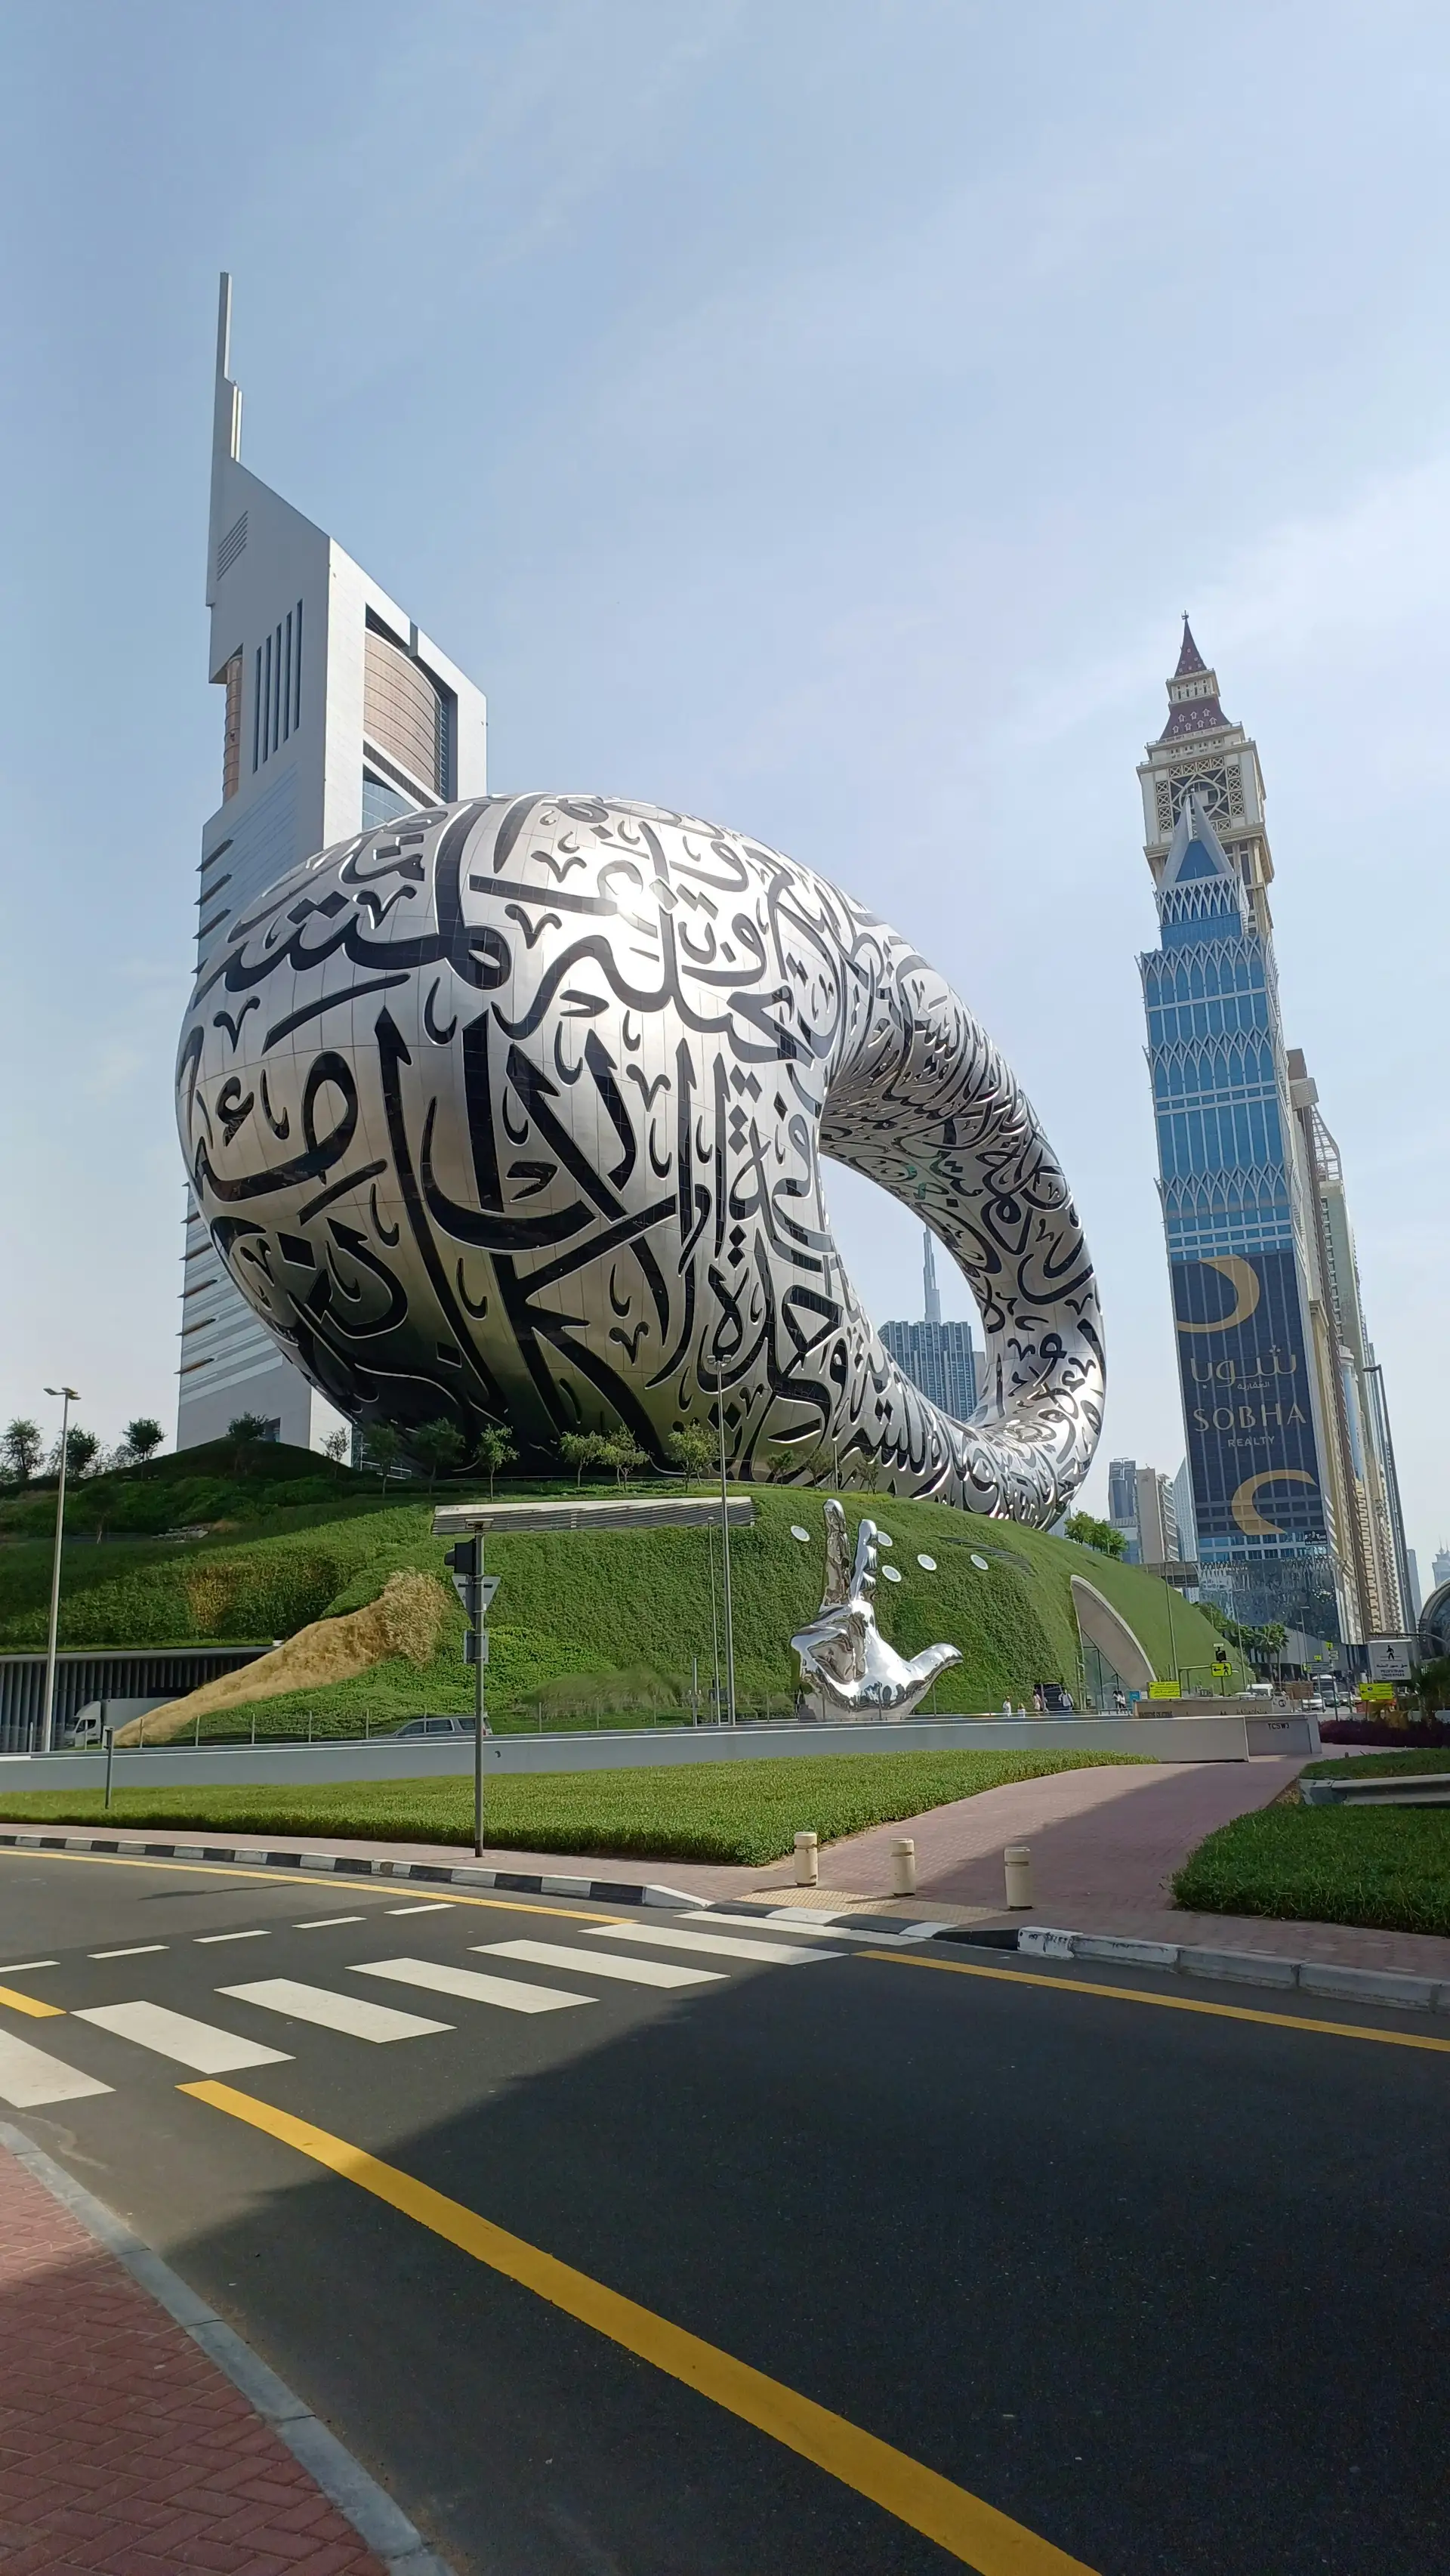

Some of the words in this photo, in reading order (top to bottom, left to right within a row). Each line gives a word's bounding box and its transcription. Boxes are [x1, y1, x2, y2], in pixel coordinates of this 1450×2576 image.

[1190, 1345, 1297, 1388] شوبا
[1237, 1381, 1270, 1391] العقارية
[1193, 1402, 1307, 1432] SOBHA
[1227, 1435, 1275, 1448] REALTY
